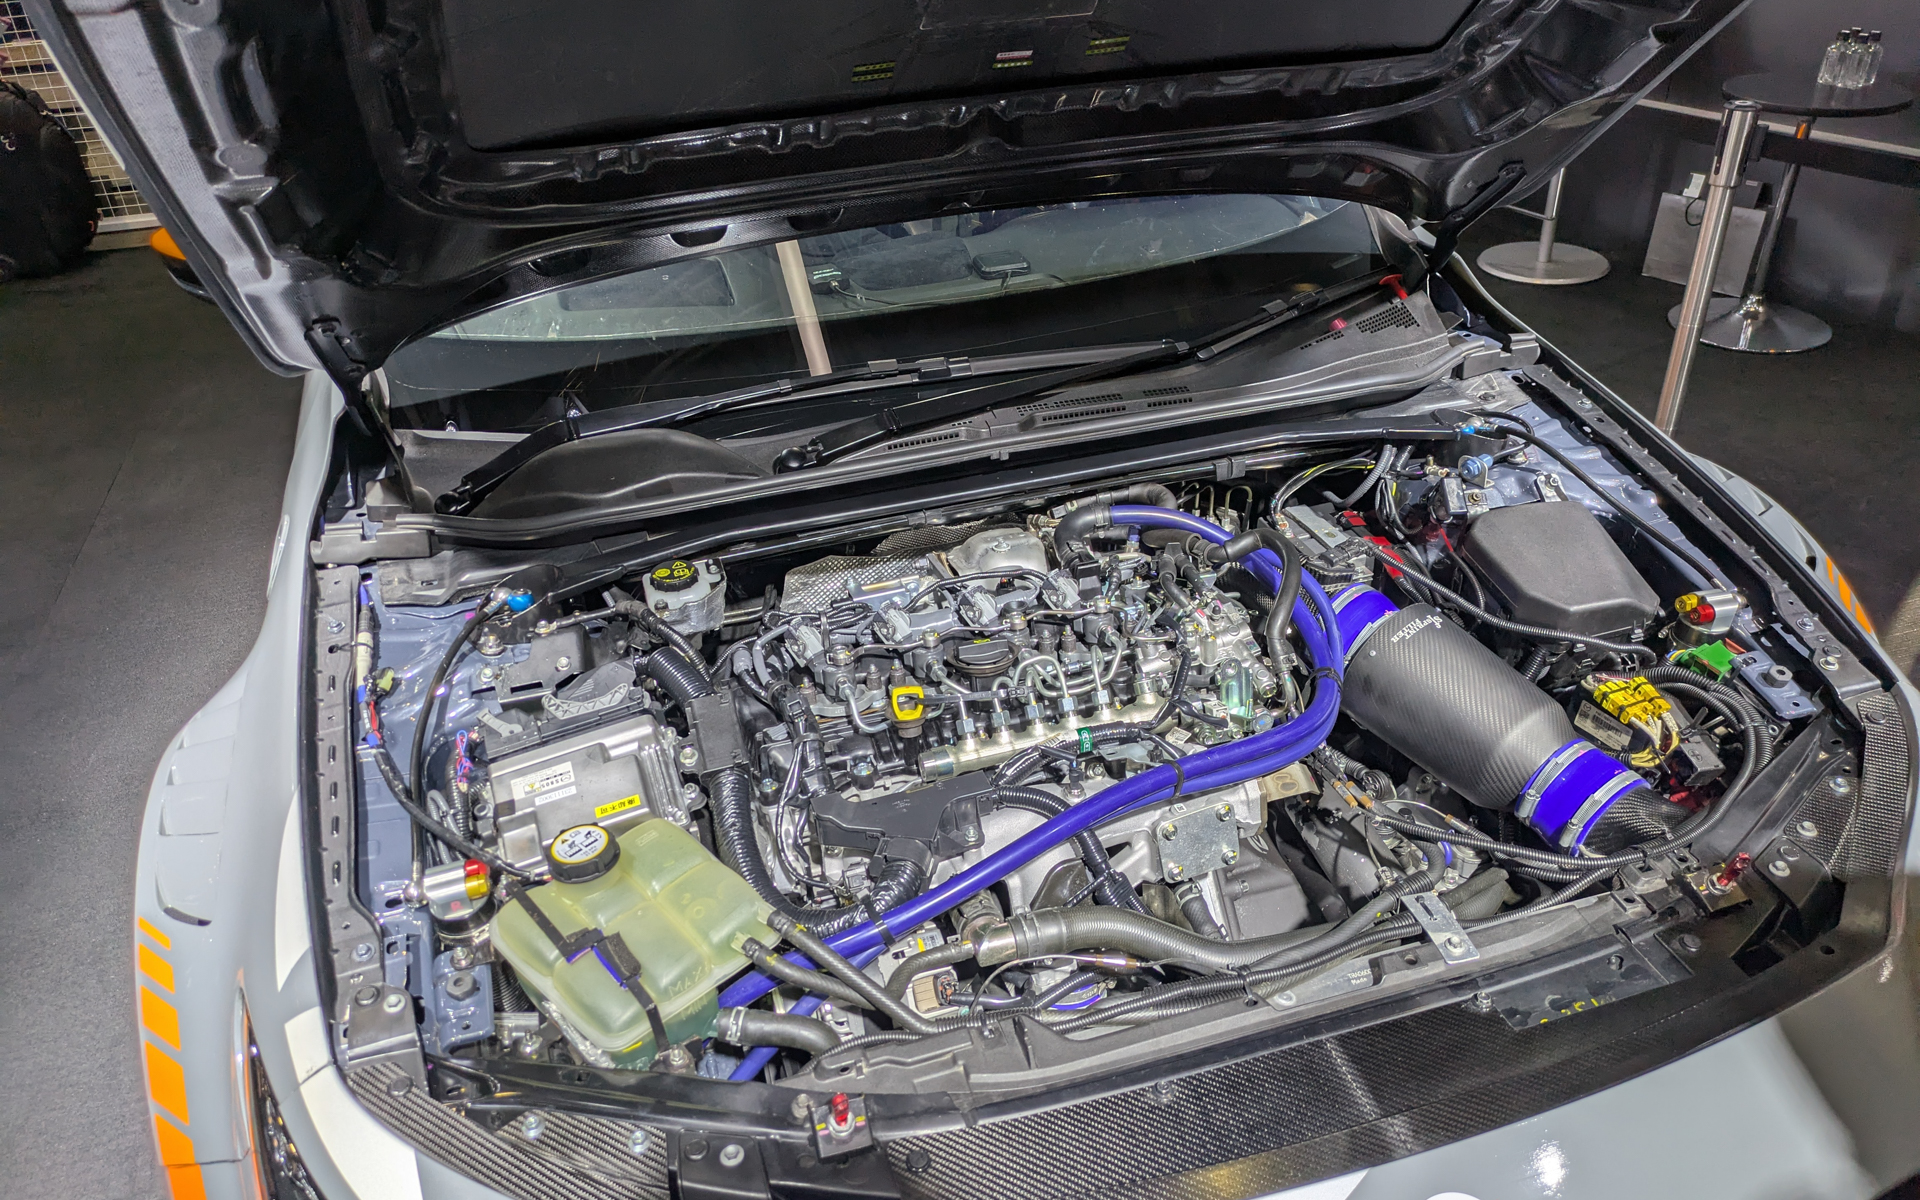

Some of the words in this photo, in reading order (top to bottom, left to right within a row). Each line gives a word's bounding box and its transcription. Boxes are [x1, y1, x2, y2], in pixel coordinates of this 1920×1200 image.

[1390, 617, 1421, 643] FILTER
[1405, 618, 1433, 640] SPRINT
[668, 966, 704, 998] MAX
